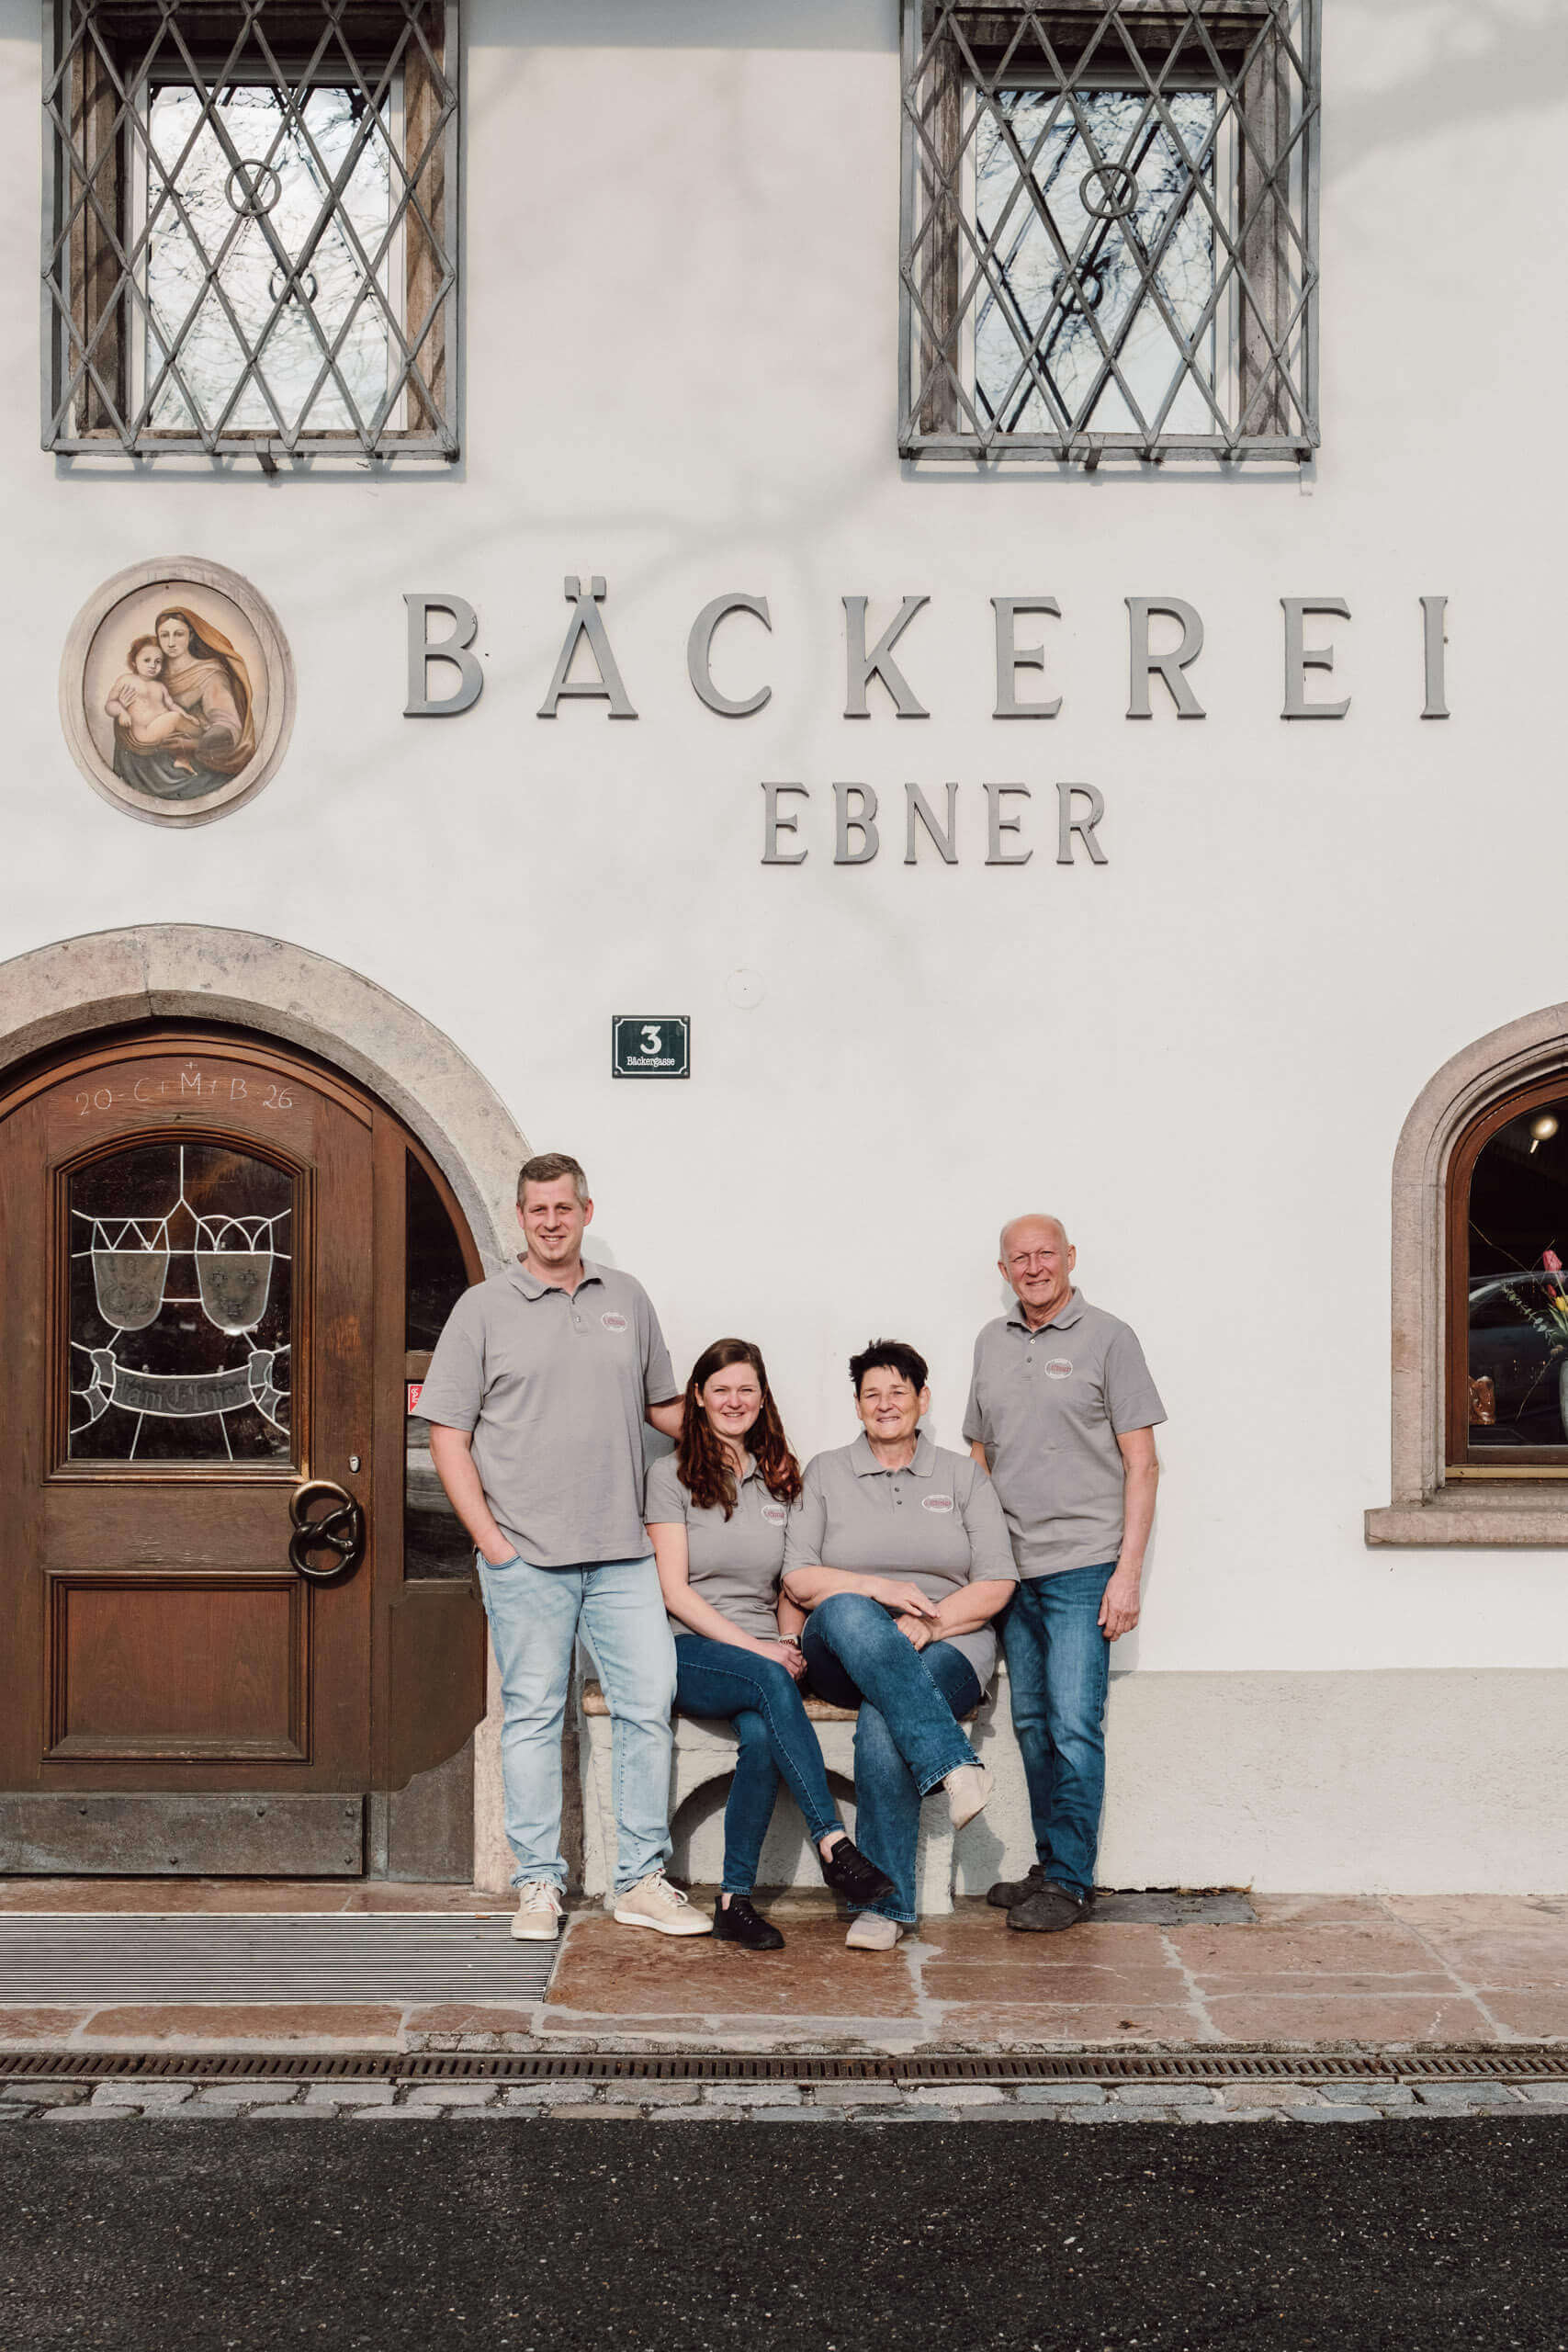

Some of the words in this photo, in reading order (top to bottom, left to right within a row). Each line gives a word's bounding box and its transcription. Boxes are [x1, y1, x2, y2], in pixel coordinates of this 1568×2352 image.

[402, 576, 1450, 719] BÄCKEREI
[761, 782, 1109, 865] EBNER
[626, 1056, 675, 1068] Bäckergasse
[640, 1024, 662, 1055] 3
